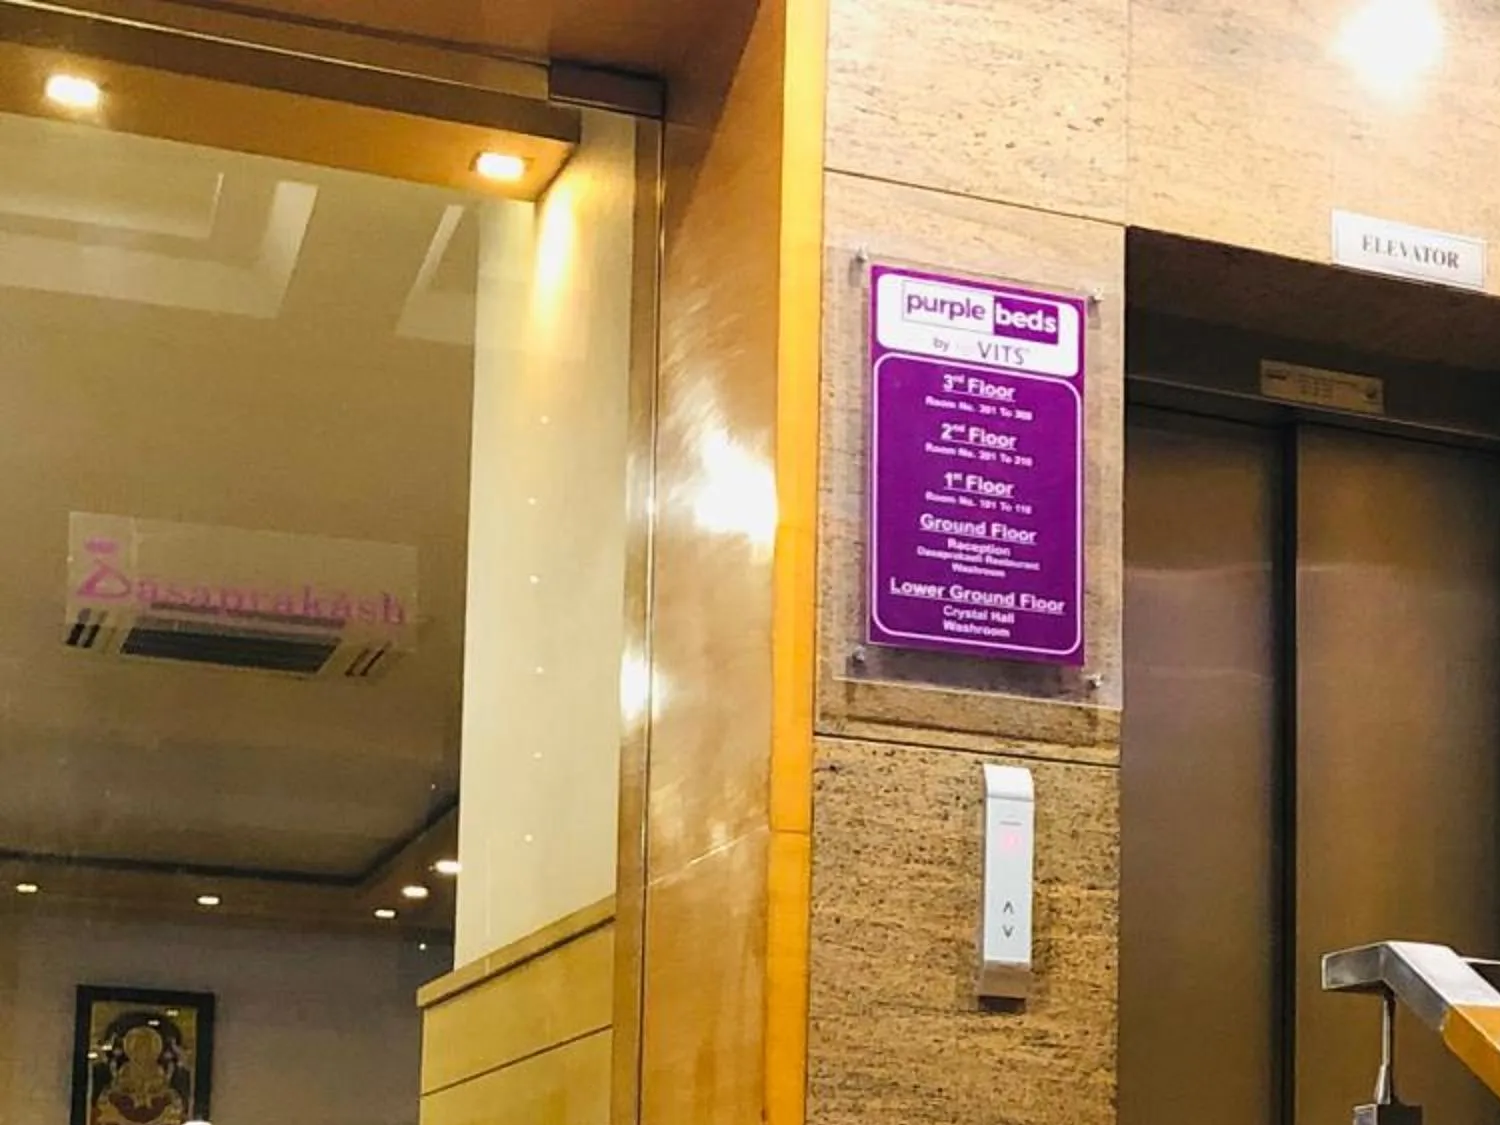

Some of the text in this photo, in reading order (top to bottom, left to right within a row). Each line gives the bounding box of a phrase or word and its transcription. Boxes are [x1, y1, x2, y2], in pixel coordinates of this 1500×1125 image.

[1362, 234, 1460, 269] ELEVATOR
[906, 293, 1058, 334] purple beds
[932, 337, 1026, 366] by VITS
[967, 378, 1016, 401] Floor
[925, 395, 957, 409] Room
[925, 442, 957, 455] Room
[968, 427, 1017, 450] Floor
[966, 475, 1015, 497] Floor
[925, 491, 957, 504] Room
[919, 513, 1038, 543] Ground Floor
[947, 538, 1011, 556] Reception
[889, 577, 1066, 614] Lower Ground Floor
[943, 605, 1015, 624] Crystal Hall
[943, 619, 1011, 637] Washroom
